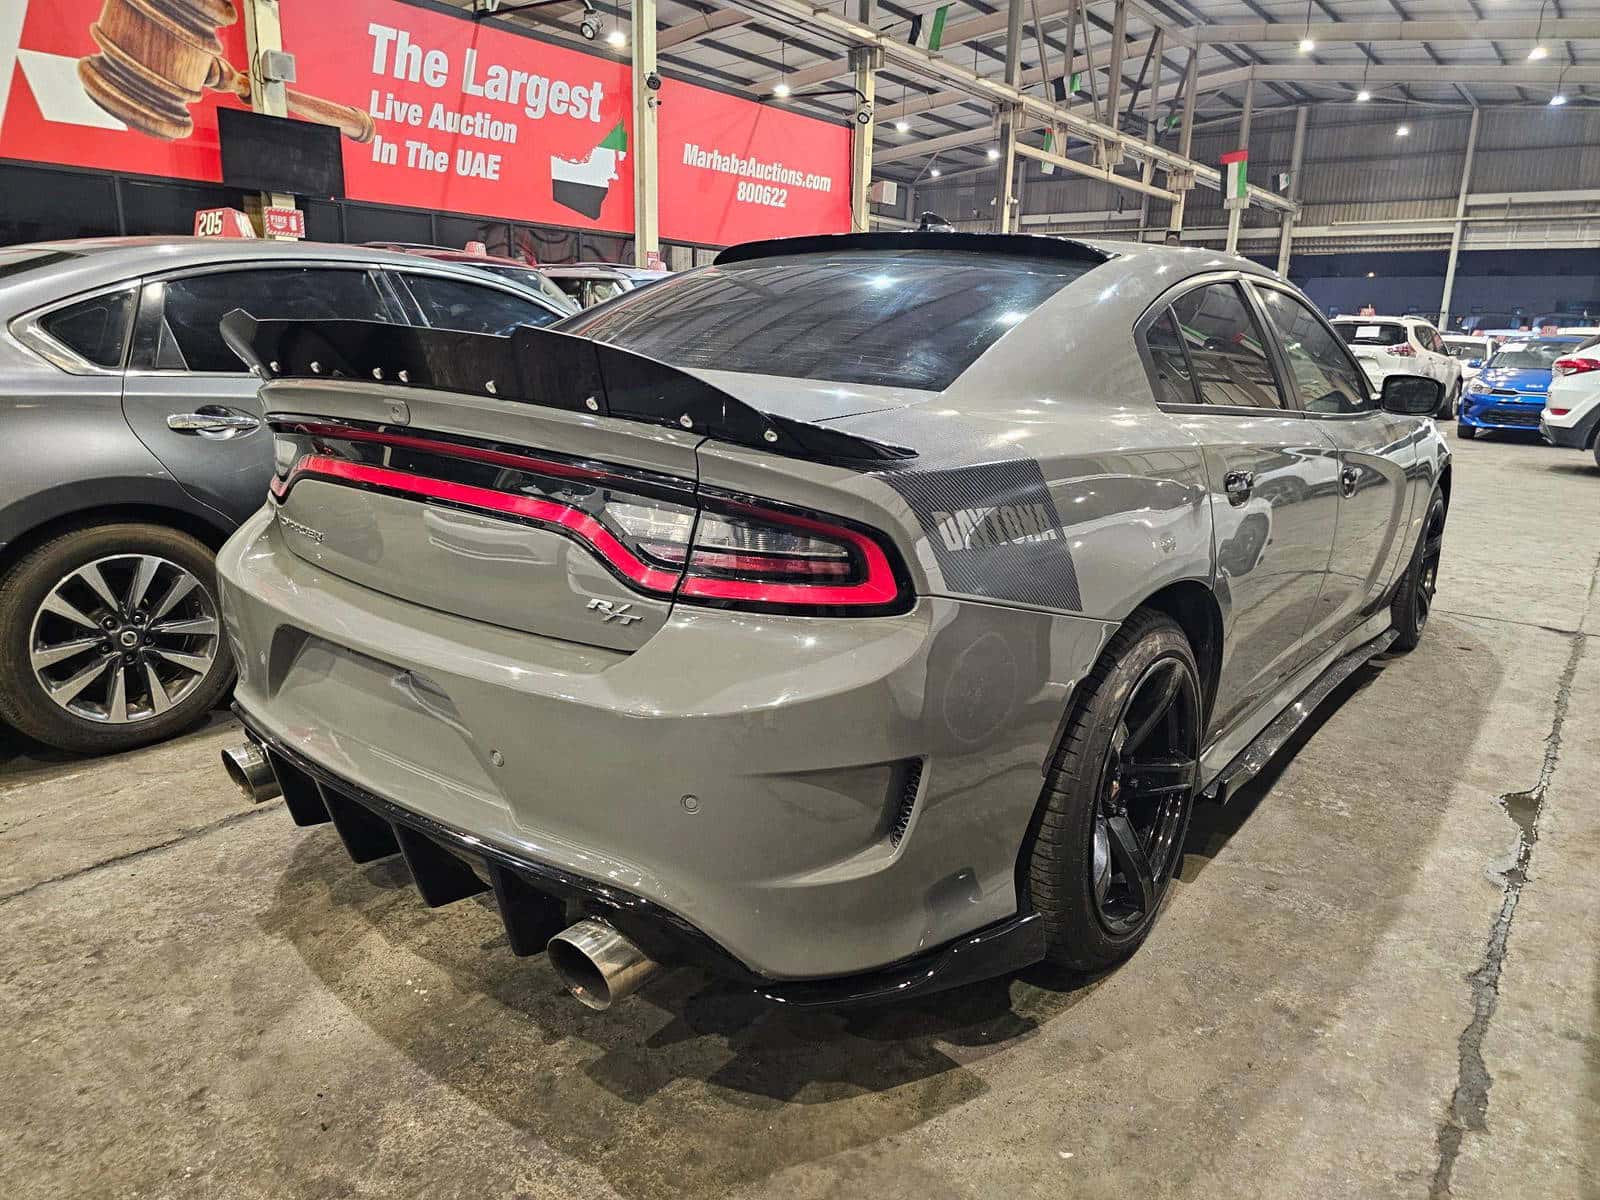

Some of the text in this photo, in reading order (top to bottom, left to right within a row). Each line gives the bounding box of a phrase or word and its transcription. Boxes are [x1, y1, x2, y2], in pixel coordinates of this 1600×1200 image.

[368, 23, 603, 122] The Largest
[369, 90, 518, 144] Live Auction
[372, 135, 502, 180] In The UAE
[682, 143, 832, 192] MarhabaAuctions.com
[736, 181, 788, 208] 800622
[198, 211, 223, 236] 205
[586, 599, 644, 625] R/T
